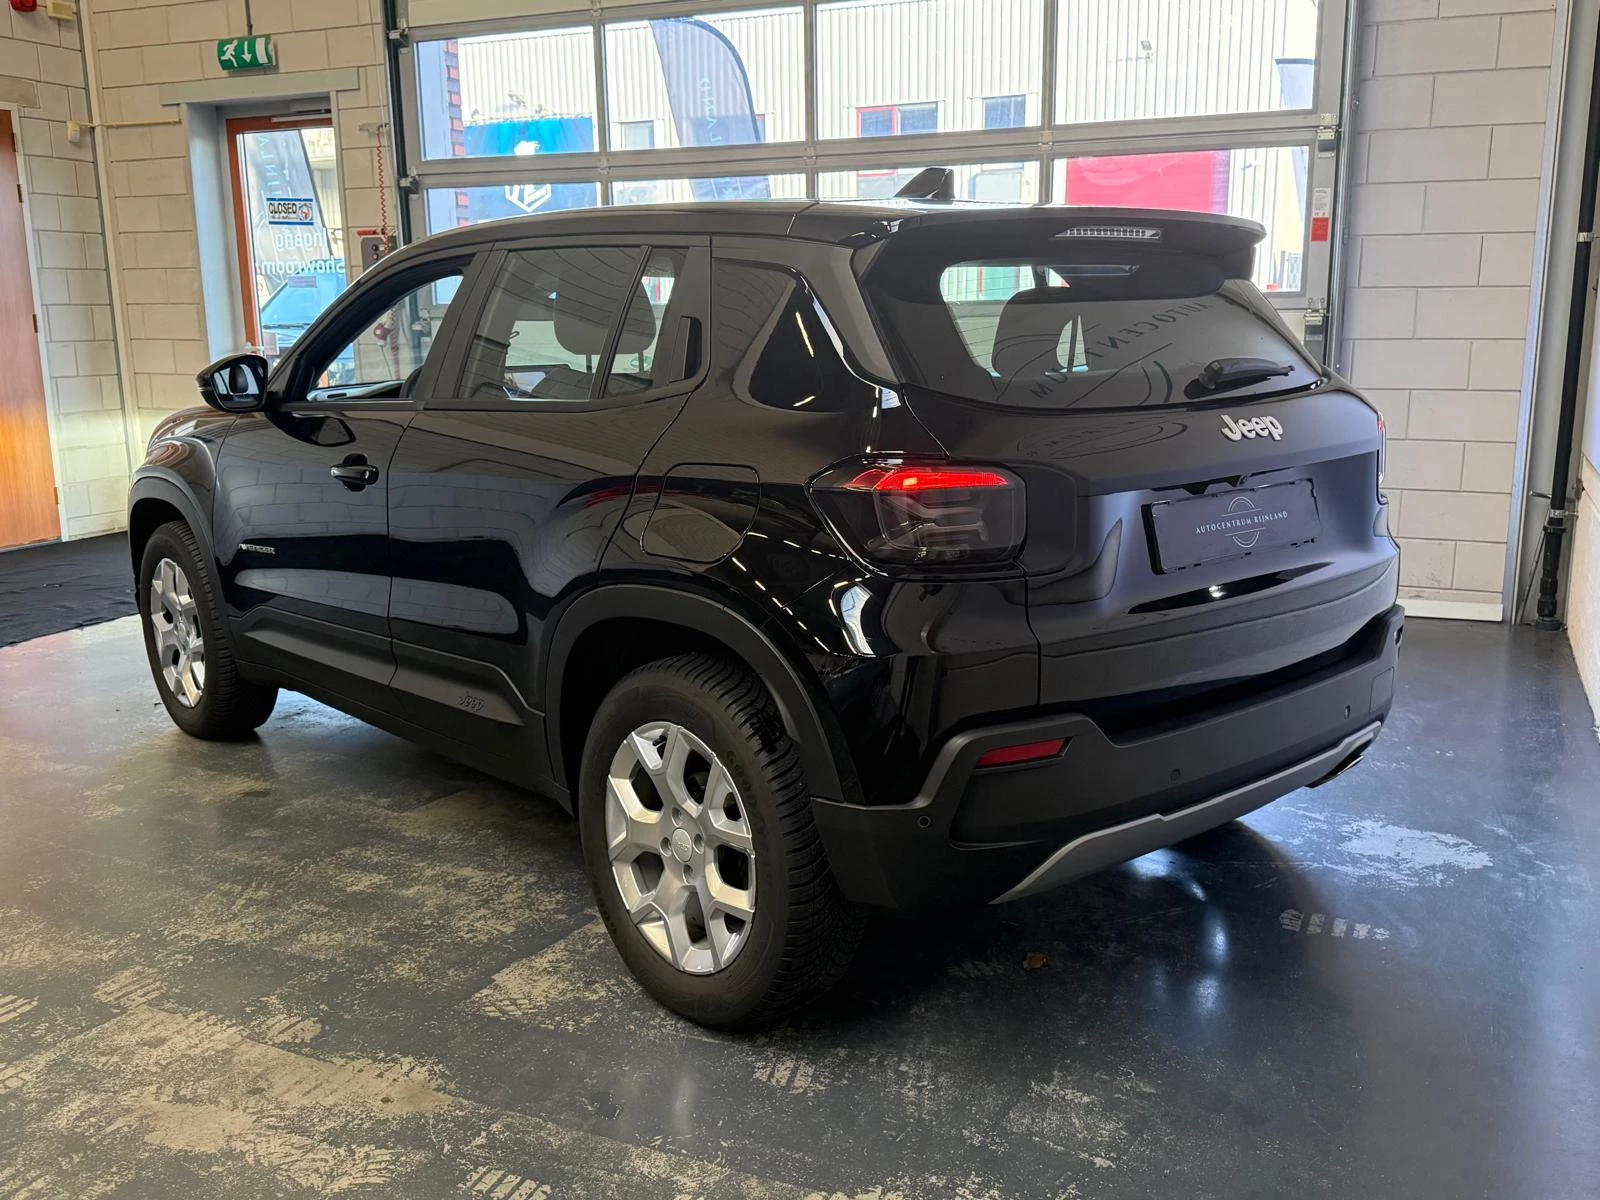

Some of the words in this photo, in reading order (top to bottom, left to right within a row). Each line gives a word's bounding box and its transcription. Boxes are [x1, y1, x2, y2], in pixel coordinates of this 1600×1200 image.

[268, 202, 297, 214] CLOSED
[1220, 414, 1283, 441] Jeep
[1195, 517, 1252, 534] AUTOCENTRUM
[1253, 510, 1288, 523] RIJNLAND
